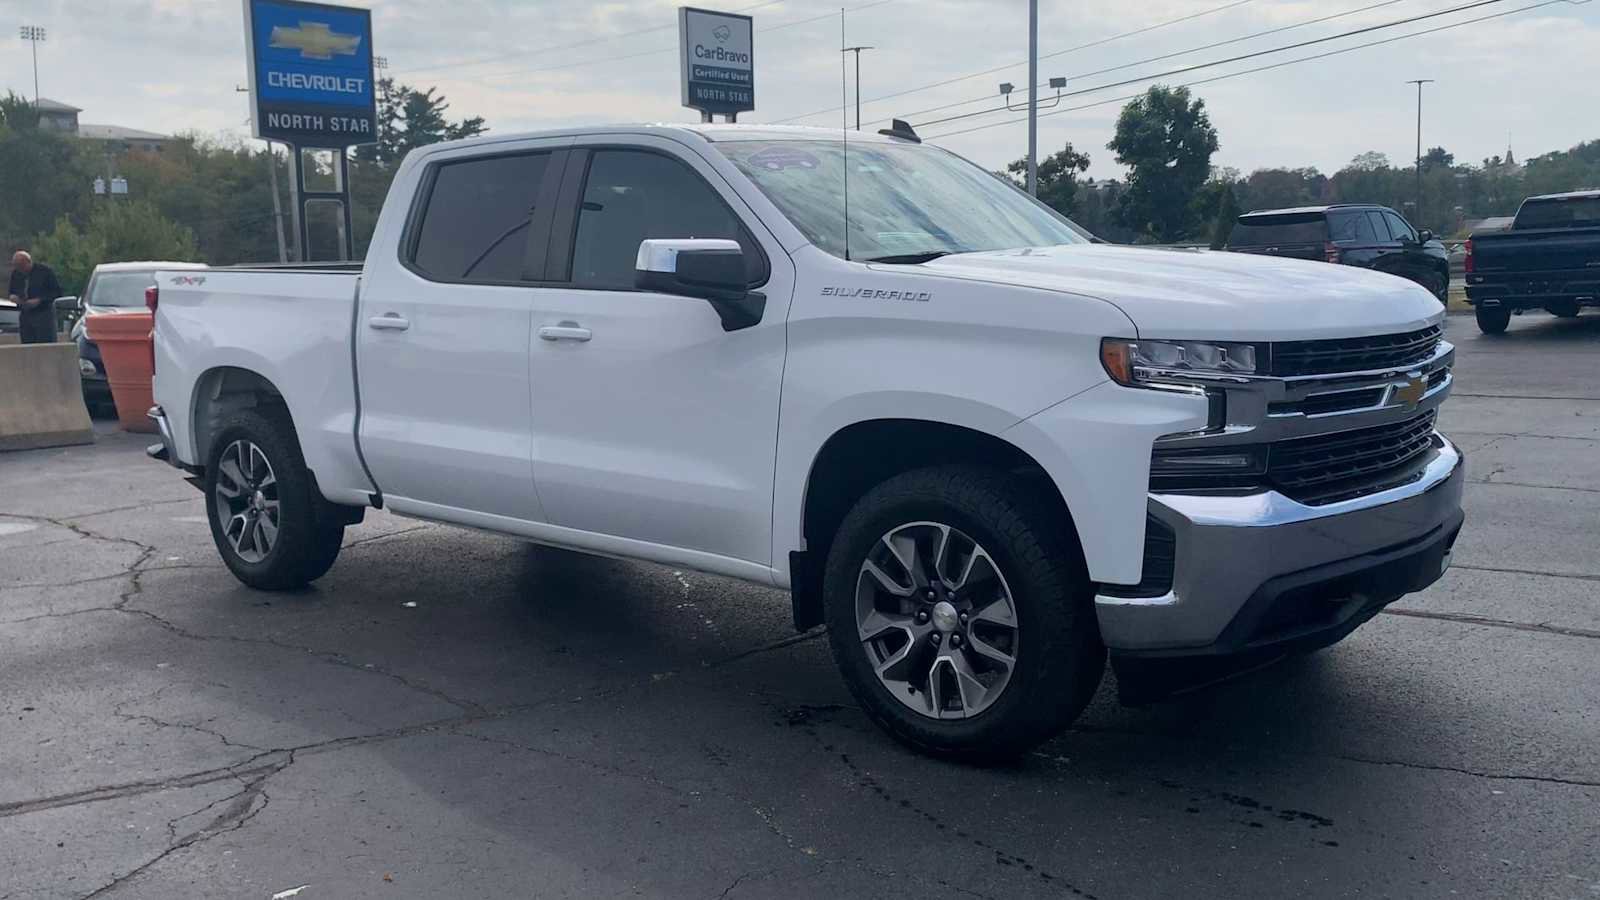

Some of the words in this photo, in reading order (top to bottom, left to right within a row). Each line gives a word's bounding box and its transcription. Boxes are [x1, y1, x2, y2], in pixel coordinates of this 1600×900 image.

[695, 44, 748, 63] CarBravo
[268, 71, 364, 93] CHEVROLET
[695, 68, 730, 79] Certified
[731, 72, 749, 81] Used
[697, 87, 725, 100] NORTH
[729, 91, 751, 103] STAR
[268, 112, 323, 130] NORTH
[330, 117, 369, 132] STAR
[821, 287, 932, 302] SILVERADO
